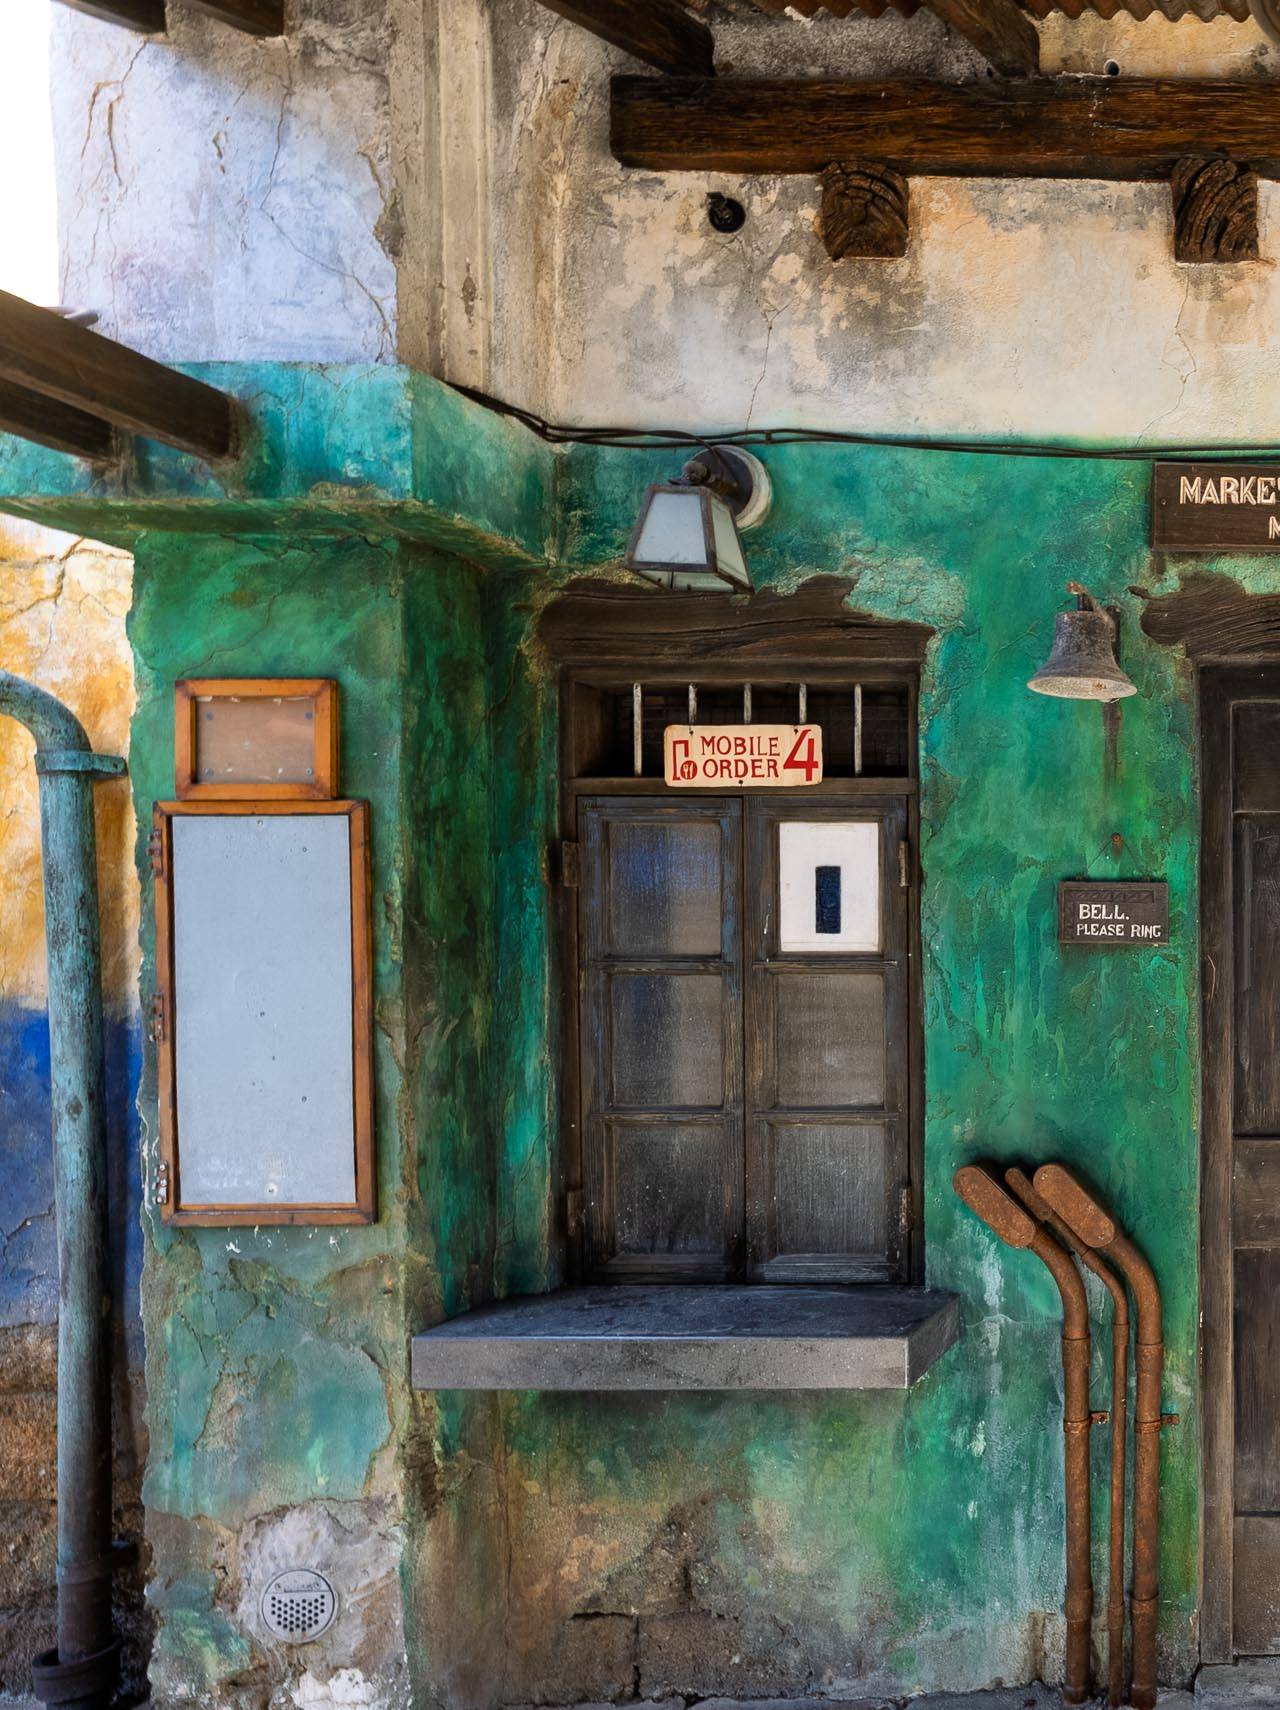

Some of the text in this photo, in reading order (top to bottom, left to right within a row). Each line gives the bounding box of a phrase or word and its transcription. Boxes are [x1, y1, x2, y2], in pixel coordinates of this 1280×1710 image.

[701, 735, 781, 756] MOBILE
[783, 728, 819, 782] 4
[702, 758, 780, 779] ORDER
[1079, 903, 1130, 920] BELL.
[1076, 923, 1162, 939] PLEASE RING
